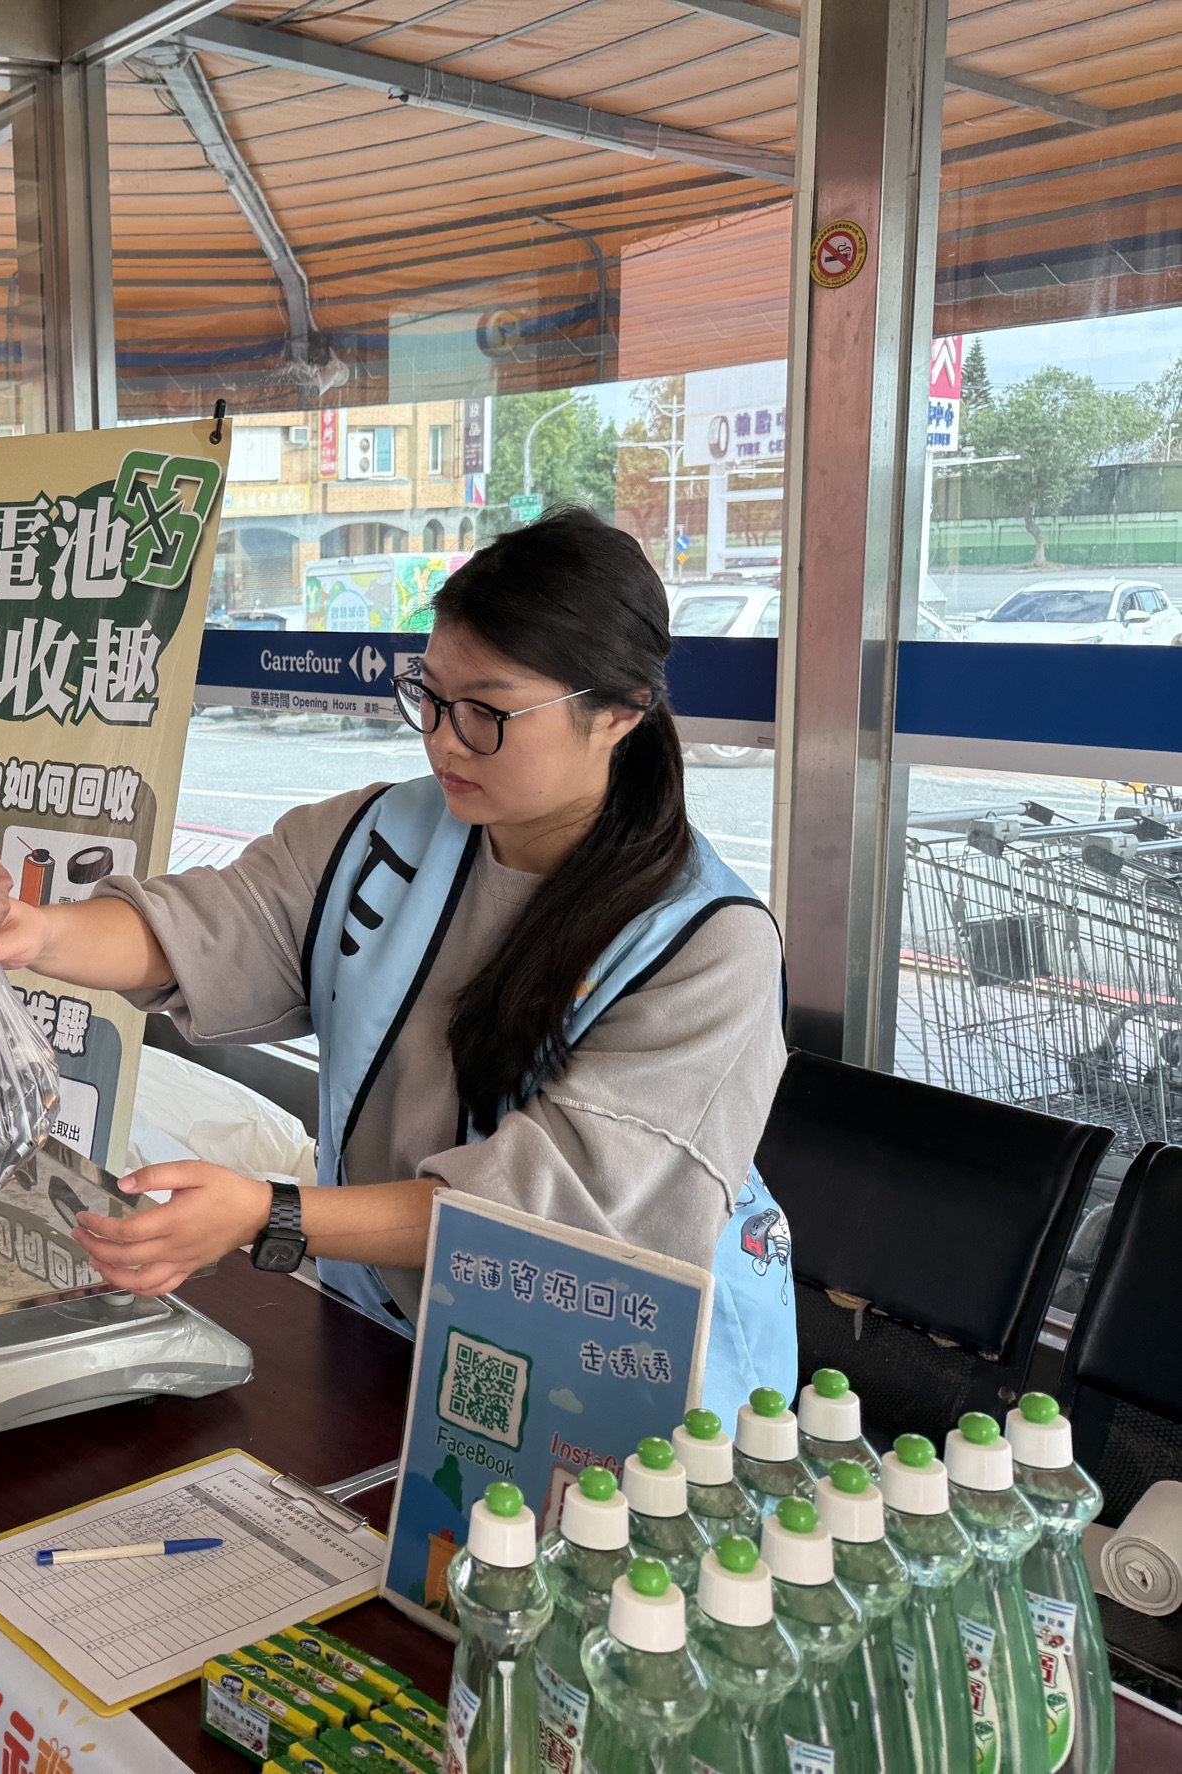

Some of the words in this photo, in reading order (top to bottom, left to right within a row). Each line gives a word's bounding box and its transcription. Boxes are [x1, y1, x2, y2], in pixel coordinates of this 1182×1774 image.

[260, 649, 342, 674] Carrefour
[293, 696, 328, 712] Opening
[333, 699, 356, 711] Hours
[451, 1252, 658, 1331] 花蓮資源回收
[436, 1425, 515, 1479] FaceBook
